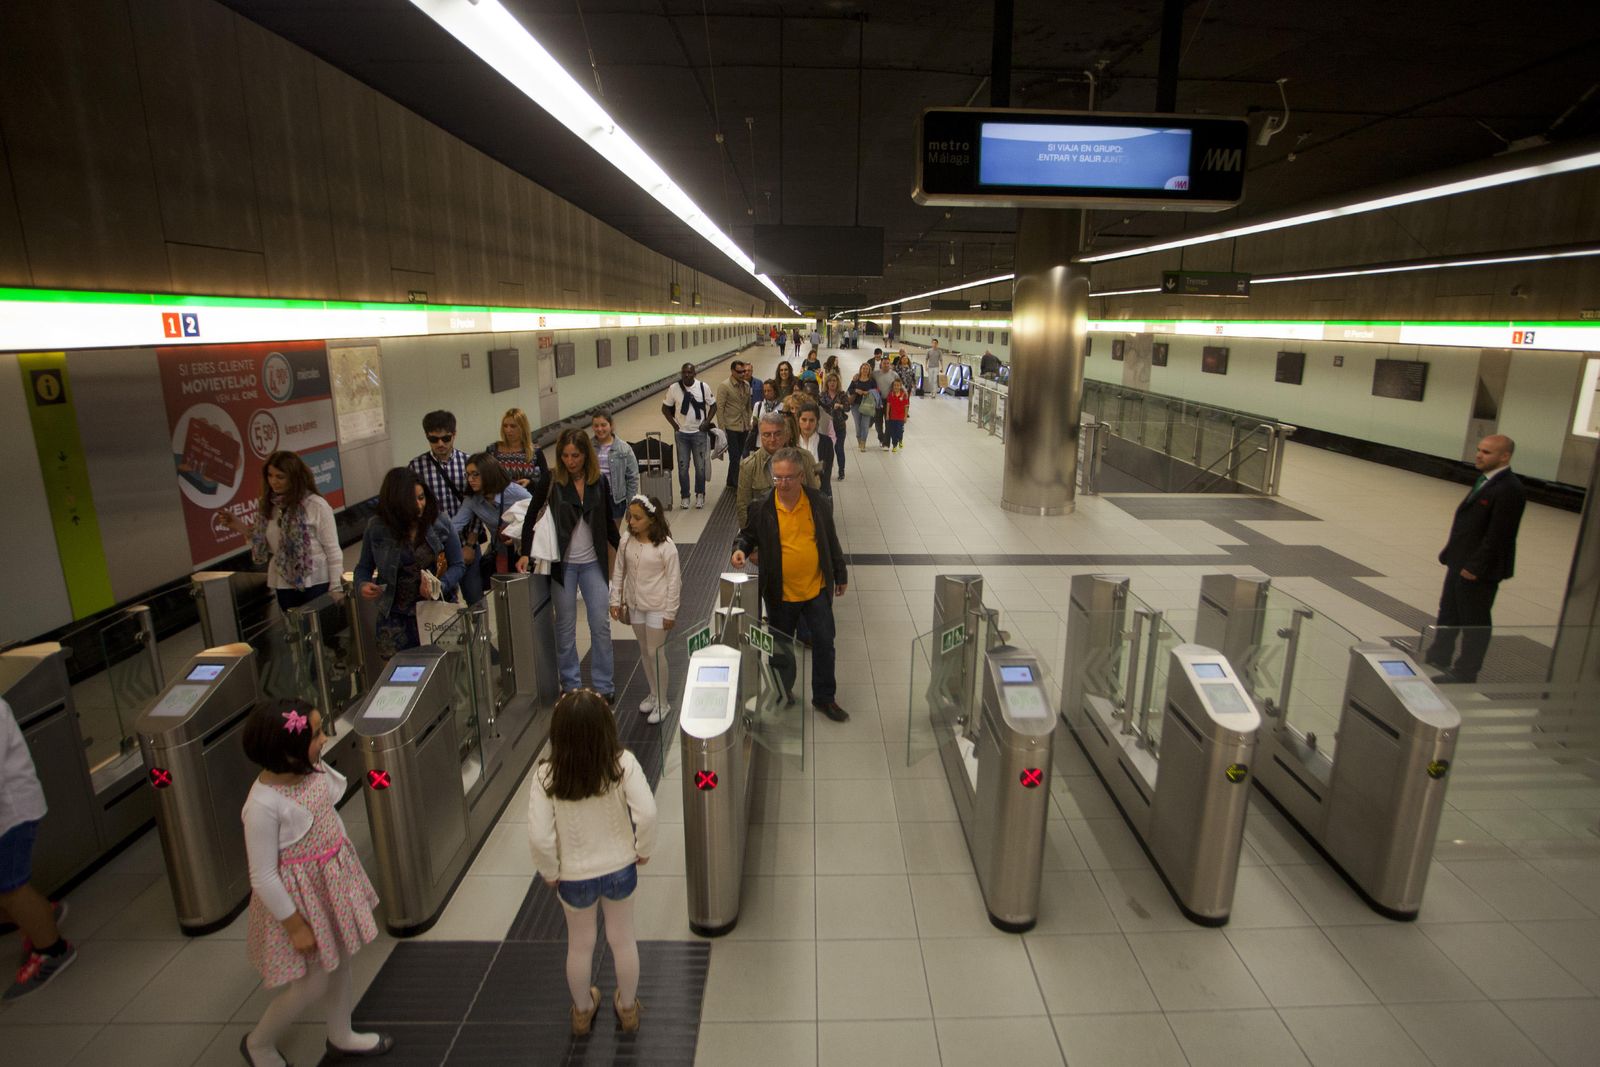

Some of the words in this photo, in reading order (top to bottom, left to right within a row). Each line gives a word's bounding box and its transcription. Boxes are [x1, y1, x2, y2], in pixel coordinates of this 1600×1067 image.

[928, 140, 970, 151] metro
[1047, 144, 1056, 152] SI
[1057, 144, 1079, 152] VIAJA
[1080, 144, 1092, 153] EN
[928, 151, 970, 167] Málaga
[1071, 154, 1078, 162] Y
[1079, 155, 1102, 163] SALIR
[178, 363, 189, 376] SI
[191, 361, 216, 375] ERES
[217, 359, 256, 373] CLIENTE
[181, 374, 257, 395] MOVIEYELMO
[241, 390, 259, 400] CINE
[224, 498, 260, 516] YELM
